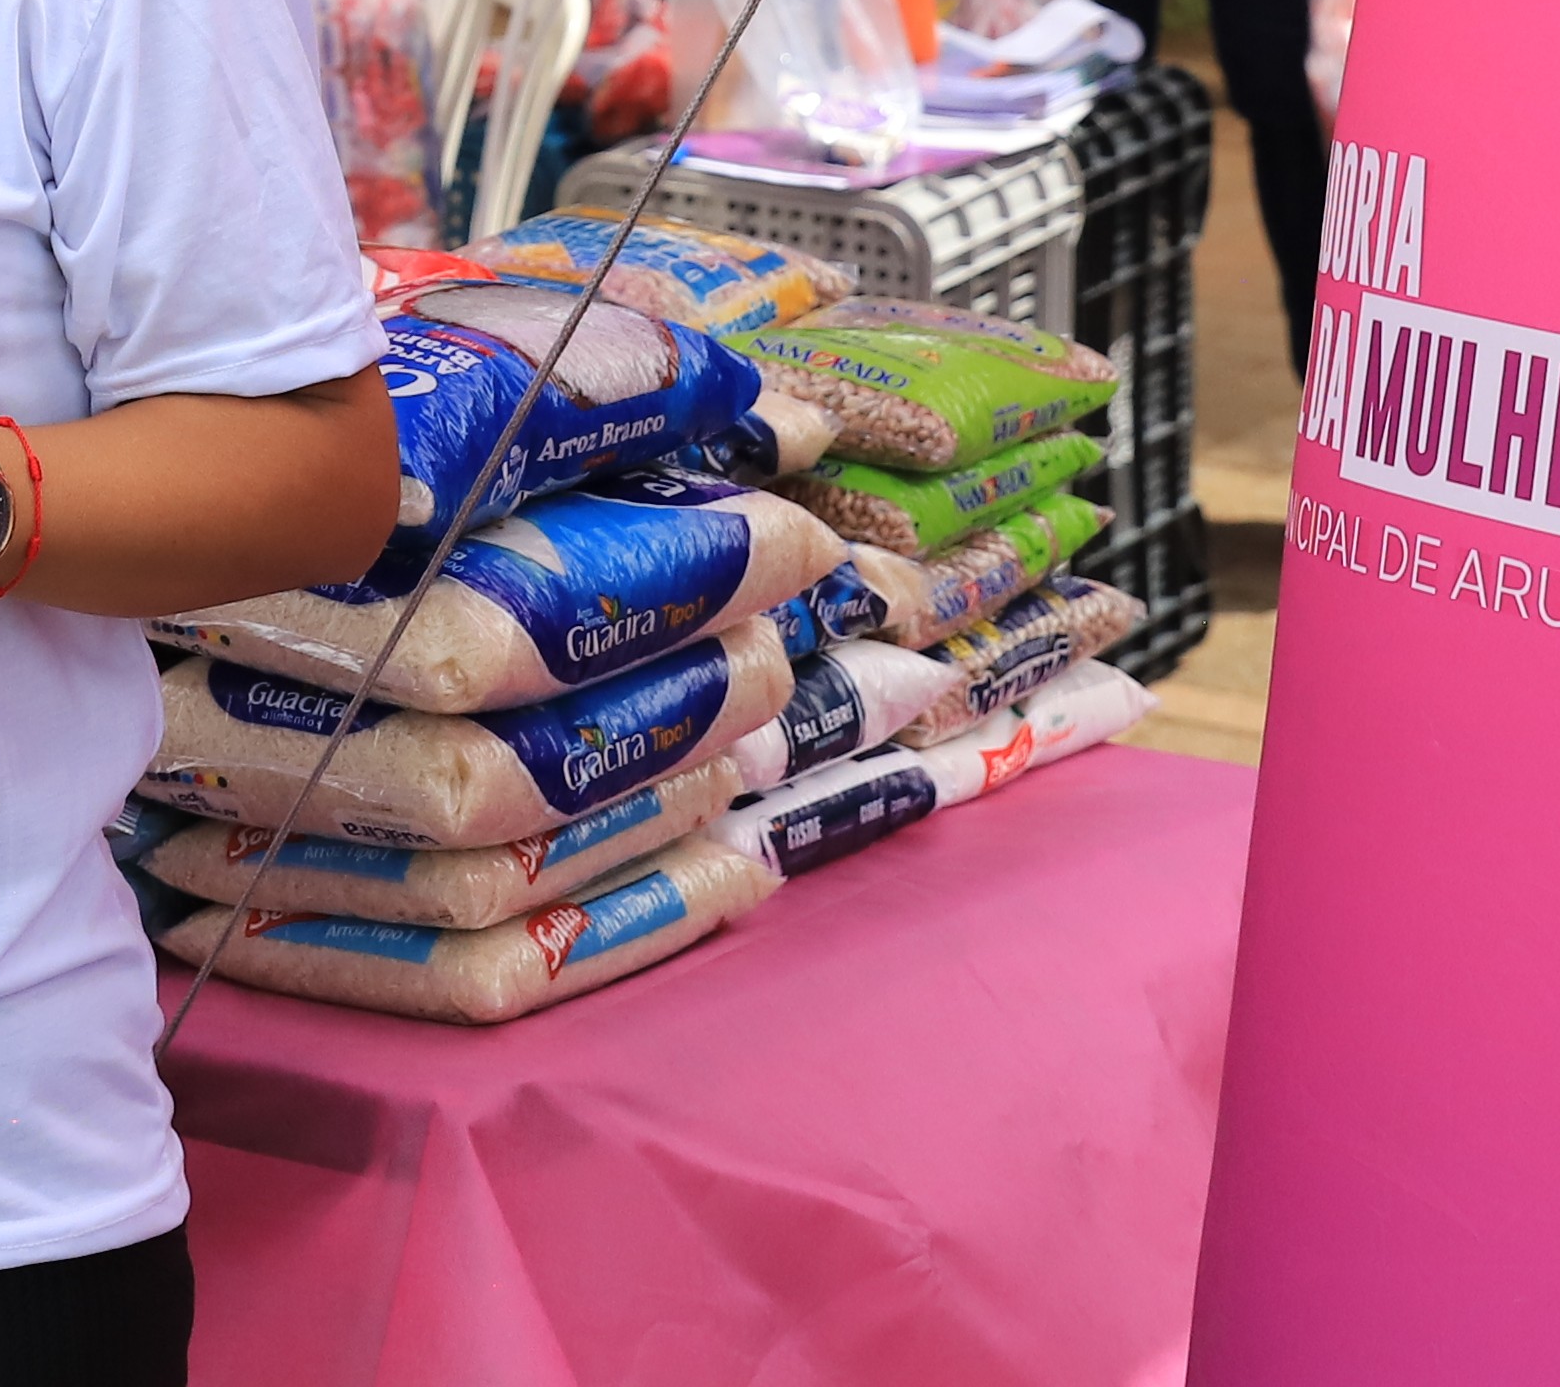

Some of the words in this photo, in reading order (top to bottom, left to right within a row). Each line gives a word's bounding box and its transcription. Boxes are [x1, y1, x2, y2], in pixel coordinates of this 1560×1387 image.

[389, 344, 466, 375] Arro
[752, 336, 911, 390] NAMORADO
[536, 430, 599, 462] Arroz
[599, 413, 666, 449] Branco
[1378, 523, 1443, 595] DE
[566, 607, 656, 662] Guacira
[247, 681, 350, 720] Guacira
